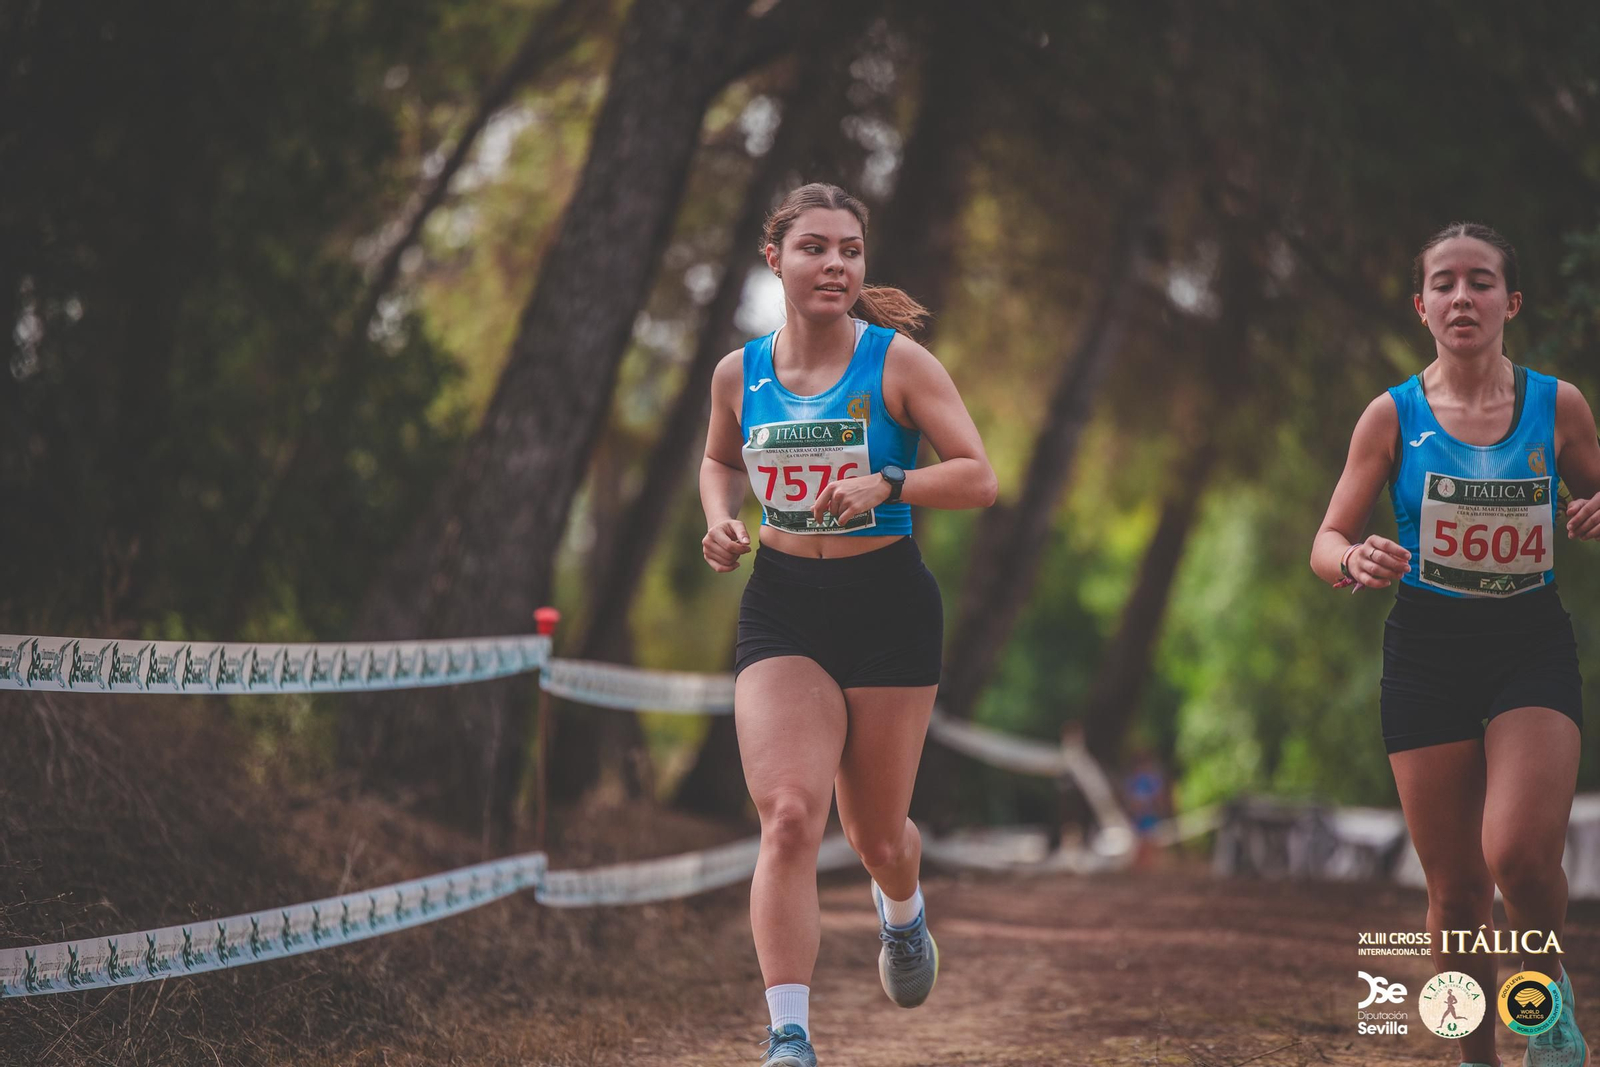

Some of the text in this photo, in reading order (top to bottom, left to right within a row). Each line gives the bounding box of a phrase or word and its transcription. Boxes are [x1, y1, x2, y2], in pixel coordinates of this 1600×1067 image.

[776, 425, 833, 440] ITÁLICA
[1464, 482, 1526, 498] ITÁLICA
[1432, 519, 1546, 564] 5604
